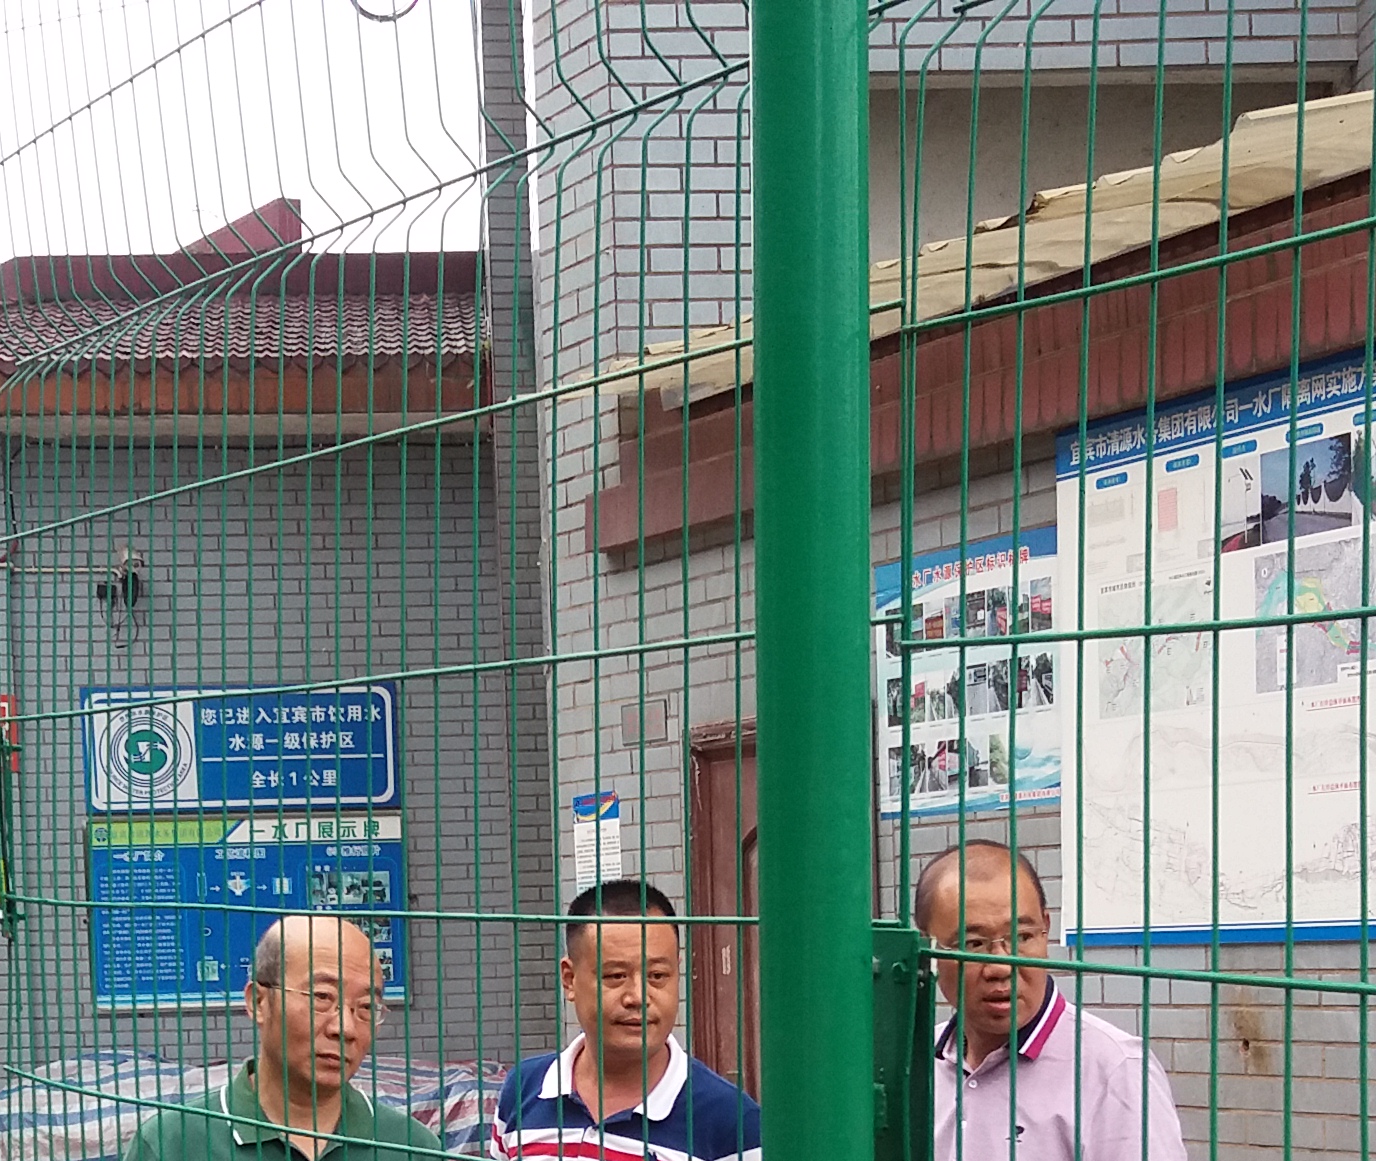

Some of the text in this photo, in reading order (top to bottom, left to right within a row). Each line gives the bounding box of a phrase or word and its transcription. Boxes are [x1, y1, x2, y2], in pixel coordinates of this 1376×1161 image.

[228, 731, 356, 751] 水源一级保护区
